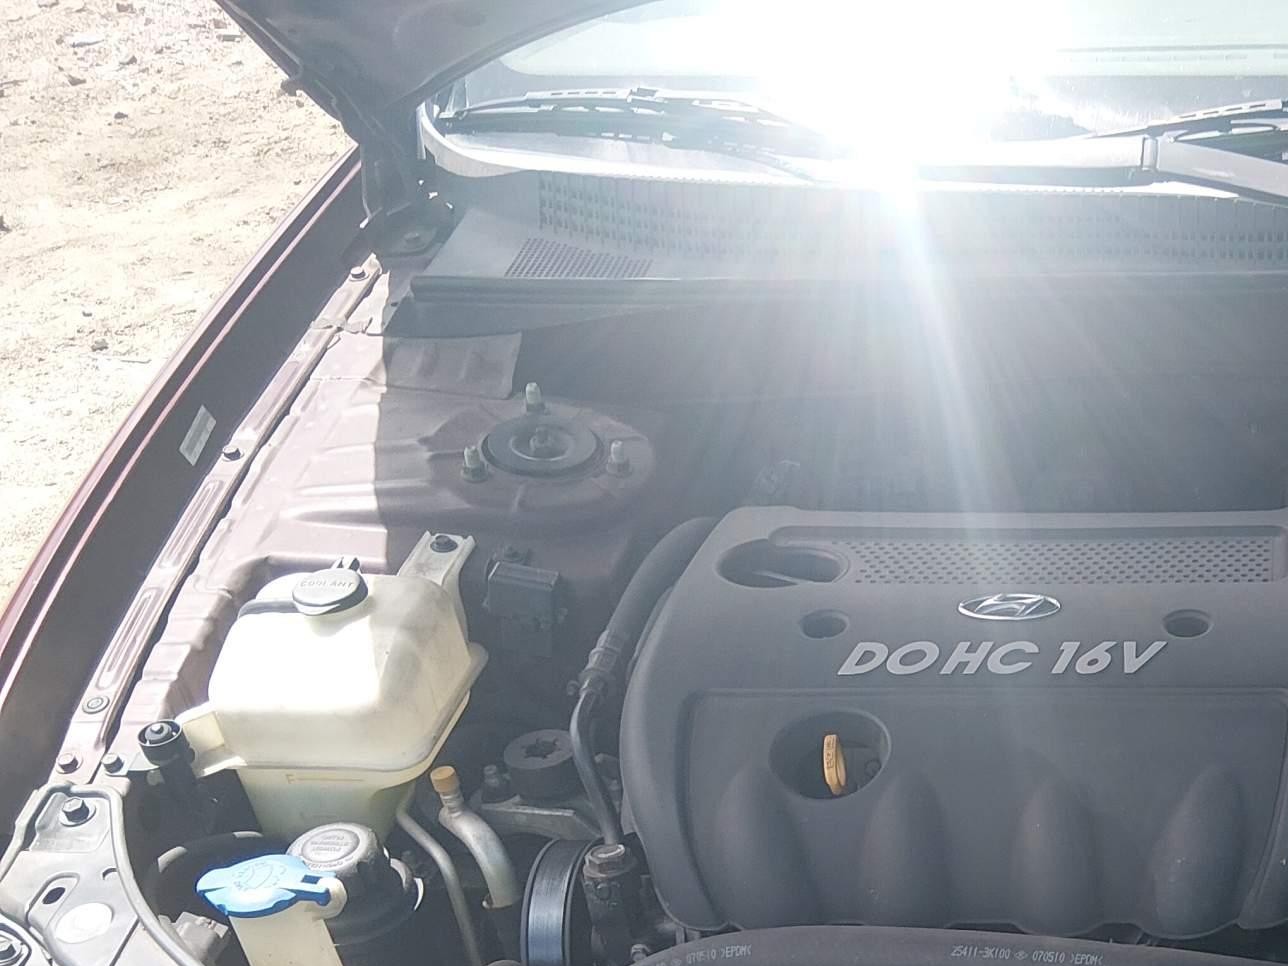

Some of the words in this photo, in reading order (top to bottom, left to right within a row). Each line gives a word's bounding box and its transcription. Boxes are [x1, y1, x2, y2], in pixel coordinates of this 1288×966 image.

[300, 579, 354, 588] COOLANT
[838, 641, 1039, 675] DOHC
[1051, 641, 1167, 674] 16V
[1032, 950, 1066, 963] 070510
